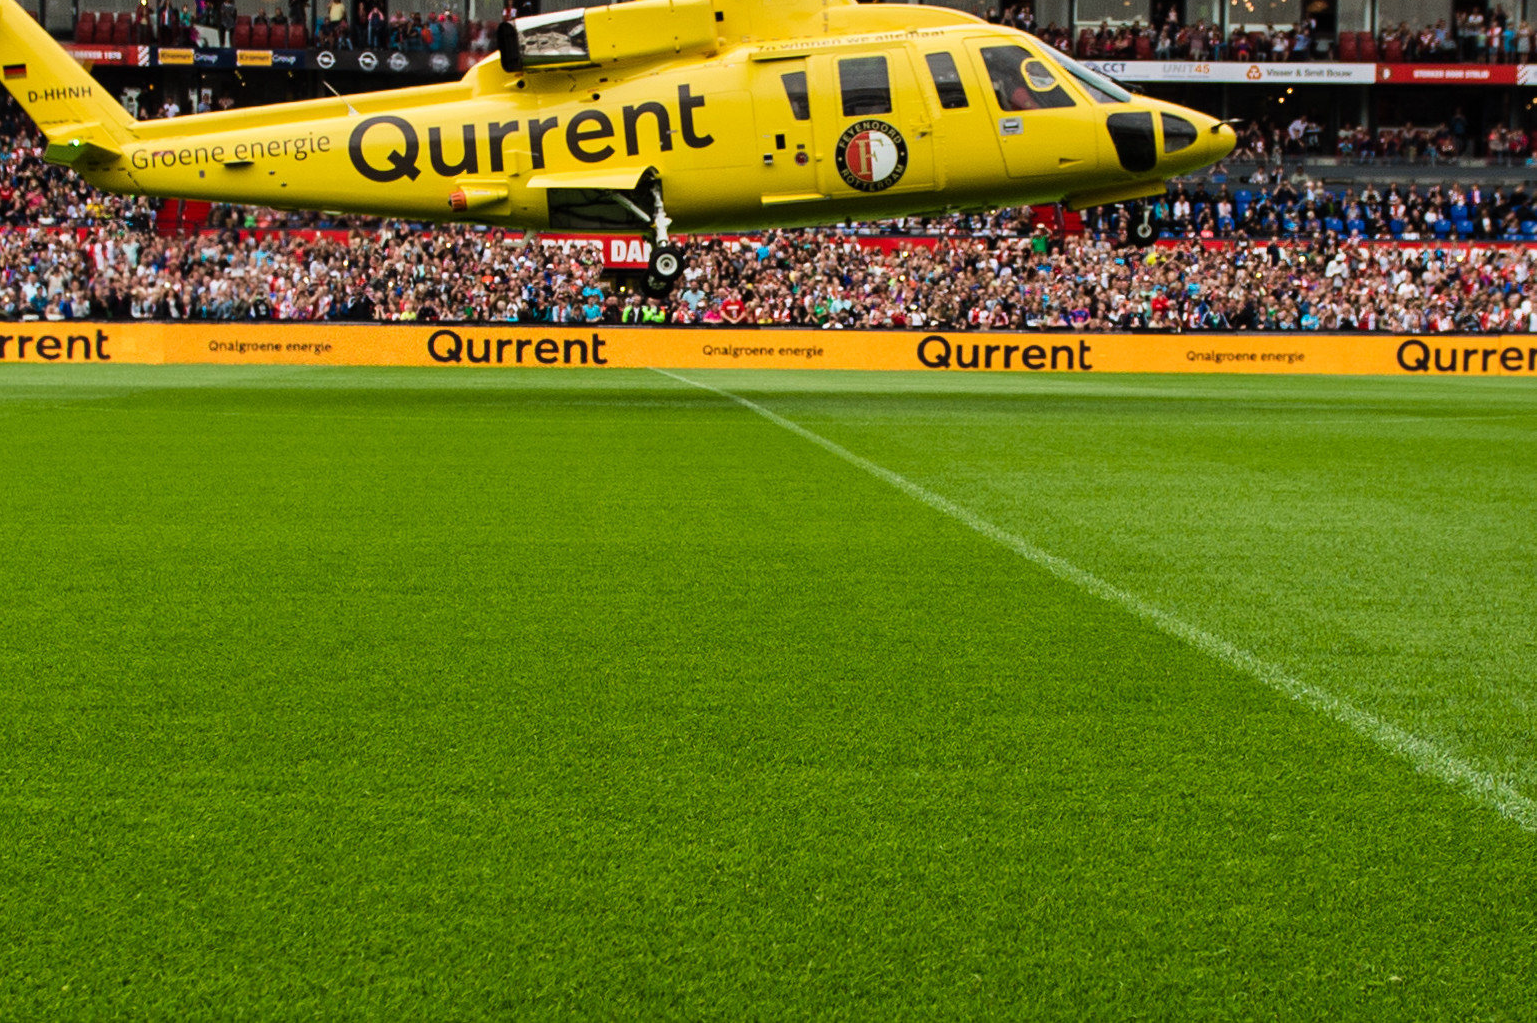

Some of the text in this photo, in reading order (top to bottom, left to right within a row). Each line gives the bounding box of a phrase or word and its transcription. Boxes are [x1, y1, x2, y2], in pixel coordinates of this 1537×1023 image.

[193, 52, 218, 64] Group
[239, 53, 297, 65] Kramer Group
[1102, 63, 1127, 73] CCT
[1163, 63, 1210, 74] UNIT45
[27, 86, 92, 104] D-HHNH
[348, 83, 715, 183] Qurrent
[839, 121, 902, 148] FEYENOORD
[131, 131, 331, 171] Groene energie
[841, 163, 904, 191] ROTTERDAM
[285, 340, 333, 355] energie
[427, 328, 609, 365] Qurrent
[778, 344, 824, 360] energie
[917, 335, 1093, 371] Qurrent
[1260, 350, 1306, 365] energie
